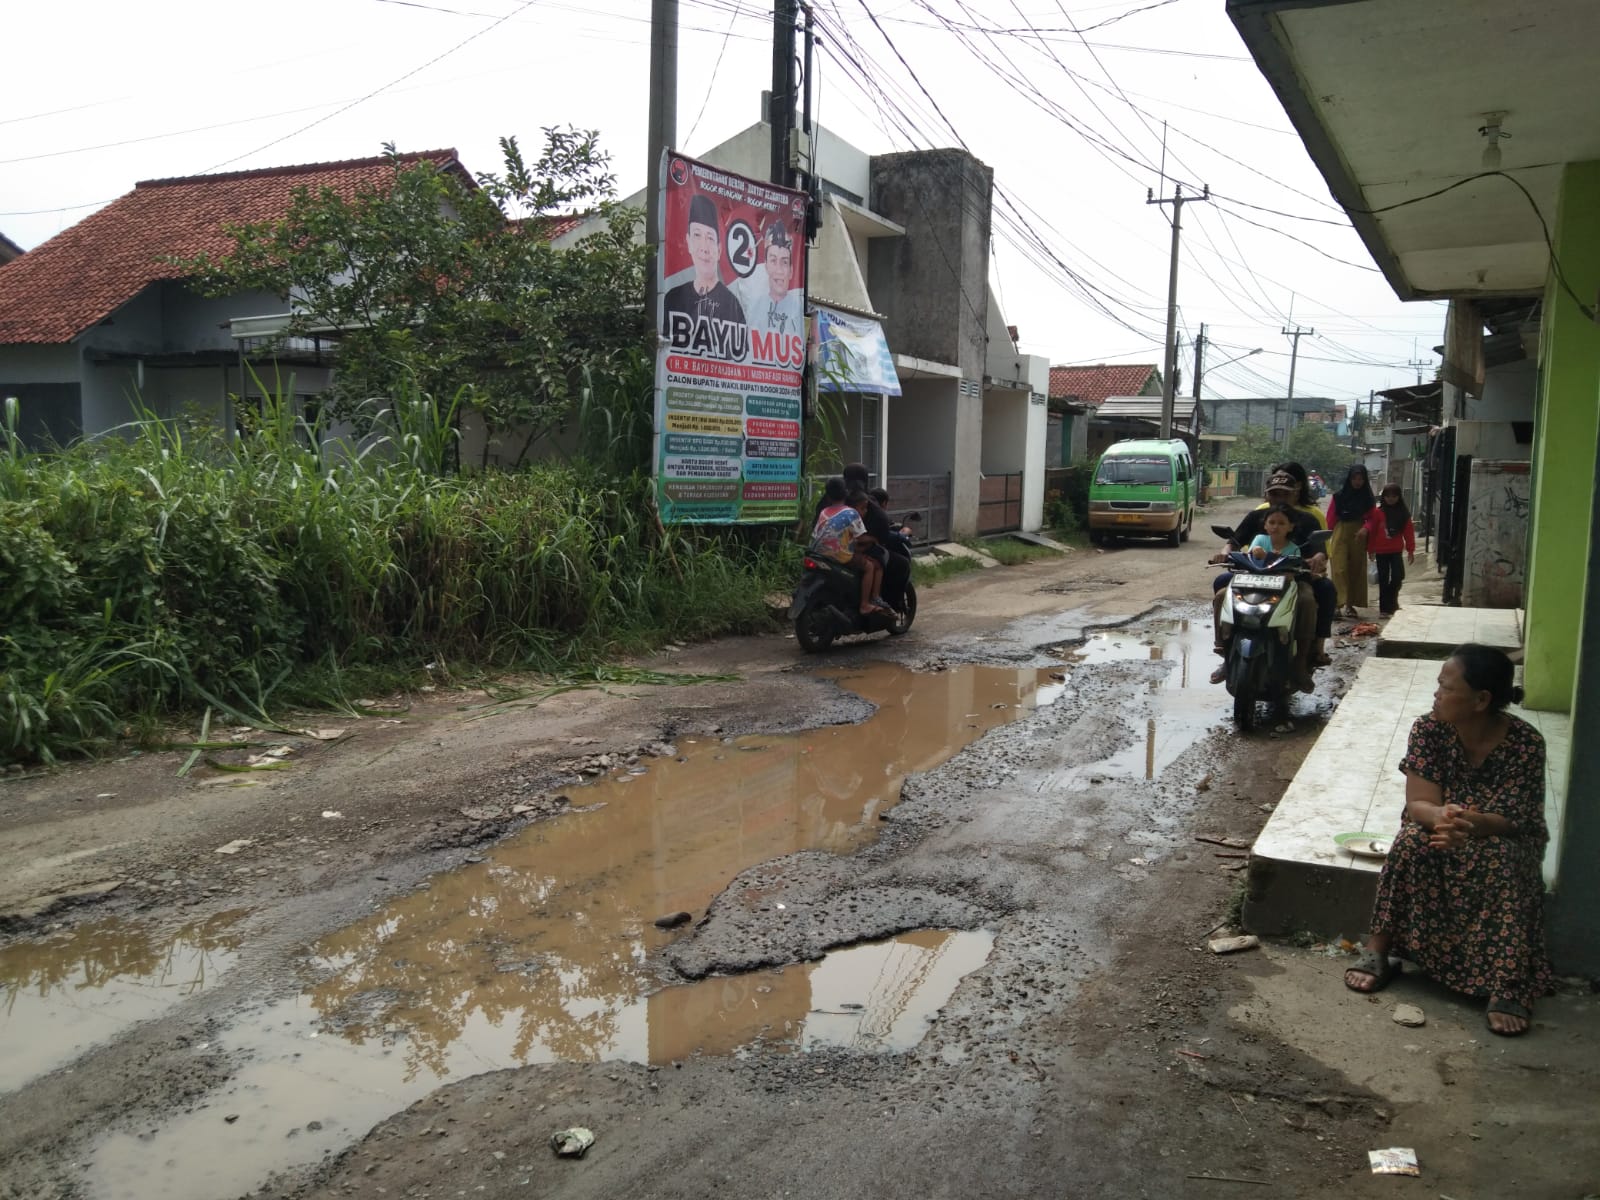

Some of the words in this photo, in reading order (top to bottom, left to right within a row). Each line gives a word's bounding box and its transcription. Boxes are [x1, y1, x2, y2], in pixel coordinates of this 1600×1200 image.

[732, 227, 750, 266] 2
[670, 313, 746, 358] BAYU
[751, 329, 803, 366] MUS
[692, 361, 710, 373] BAYU
[667, 375, 691, 385] CALON
[692, 378, 714, 388] BUPATI
